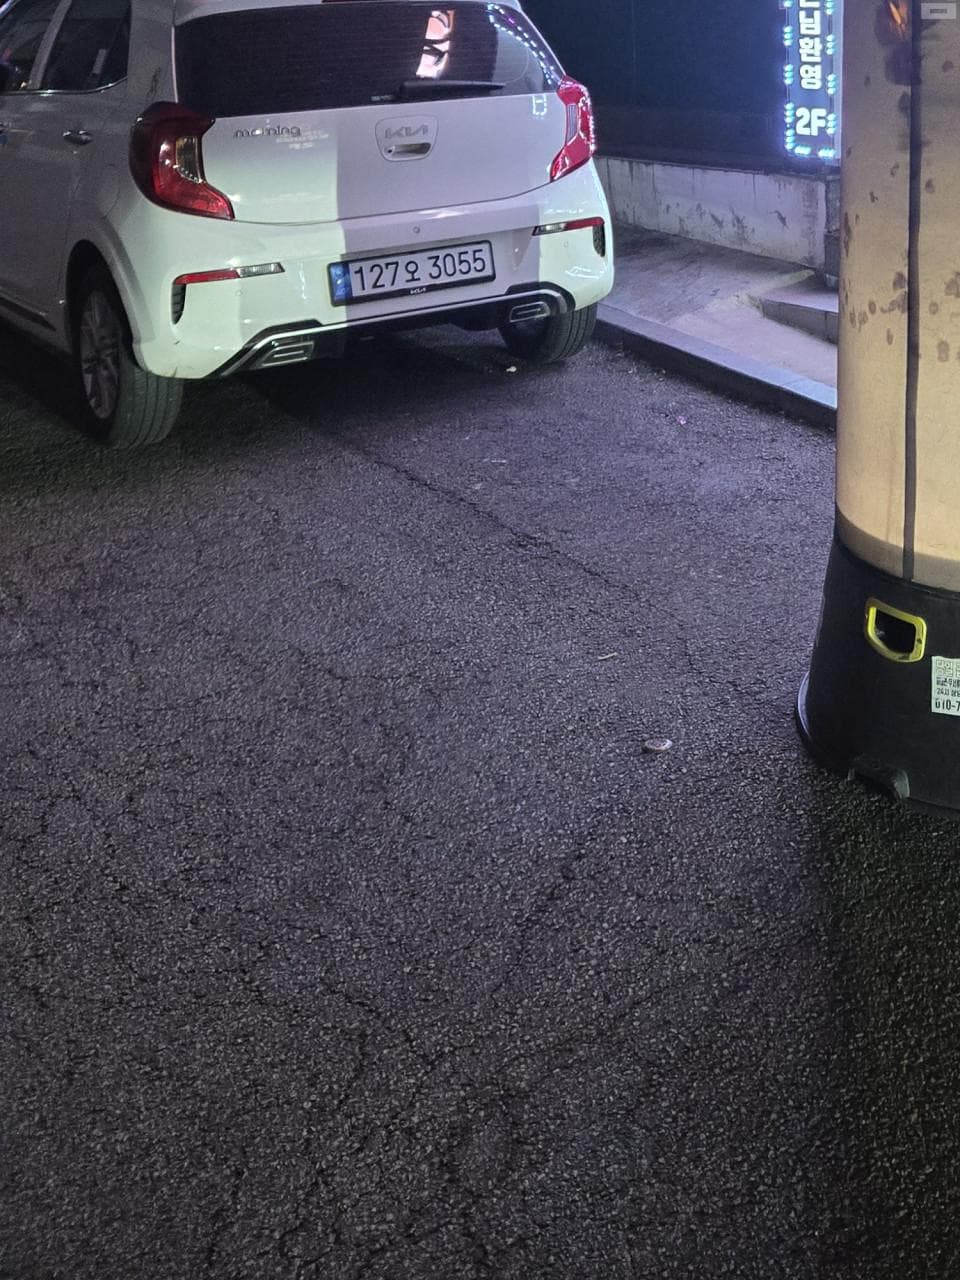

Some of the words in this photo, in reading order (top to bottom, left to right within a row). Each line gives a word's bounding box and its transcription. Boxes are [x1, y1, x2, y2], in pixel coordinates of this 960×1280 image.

[795, 107, 827, 137] 2F
[354, 260, 421, 292] 127오
[427, 249, 487, 280] 3055
